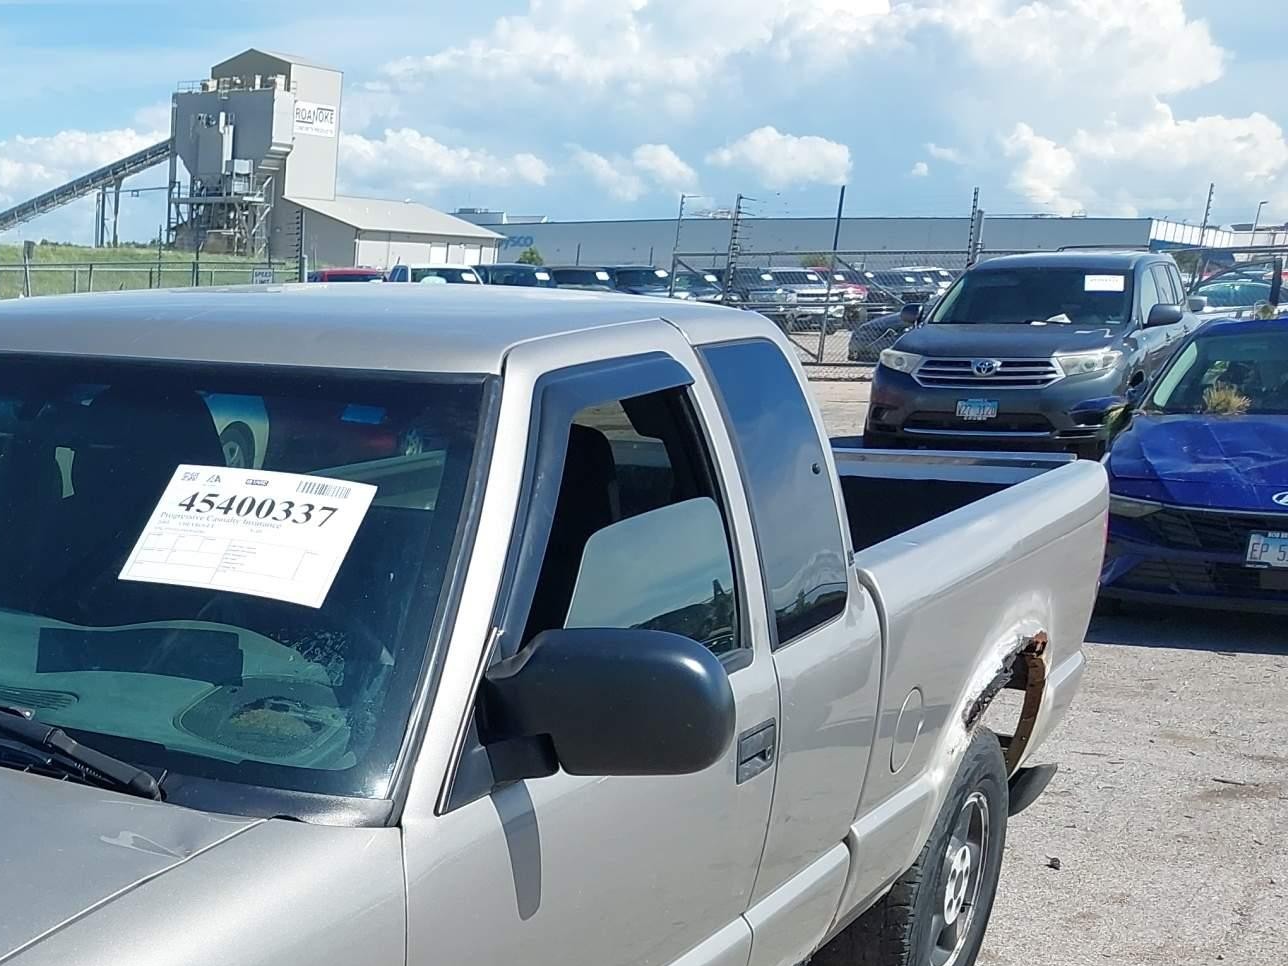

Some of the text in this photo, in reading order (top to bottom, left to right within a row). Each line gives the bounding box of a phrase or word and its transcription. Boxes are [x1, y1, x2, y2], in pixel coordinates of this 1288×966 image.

[296, 107, 335, 125] ROANOKE
[178, 491, 339, 528] 45400337
[160, 511, 206, 522] Progressive
[206, 515, 241, 525] Casualty
[242, 518, 283, 530] Insurance
[1250, 543, 1270, 561] EP
